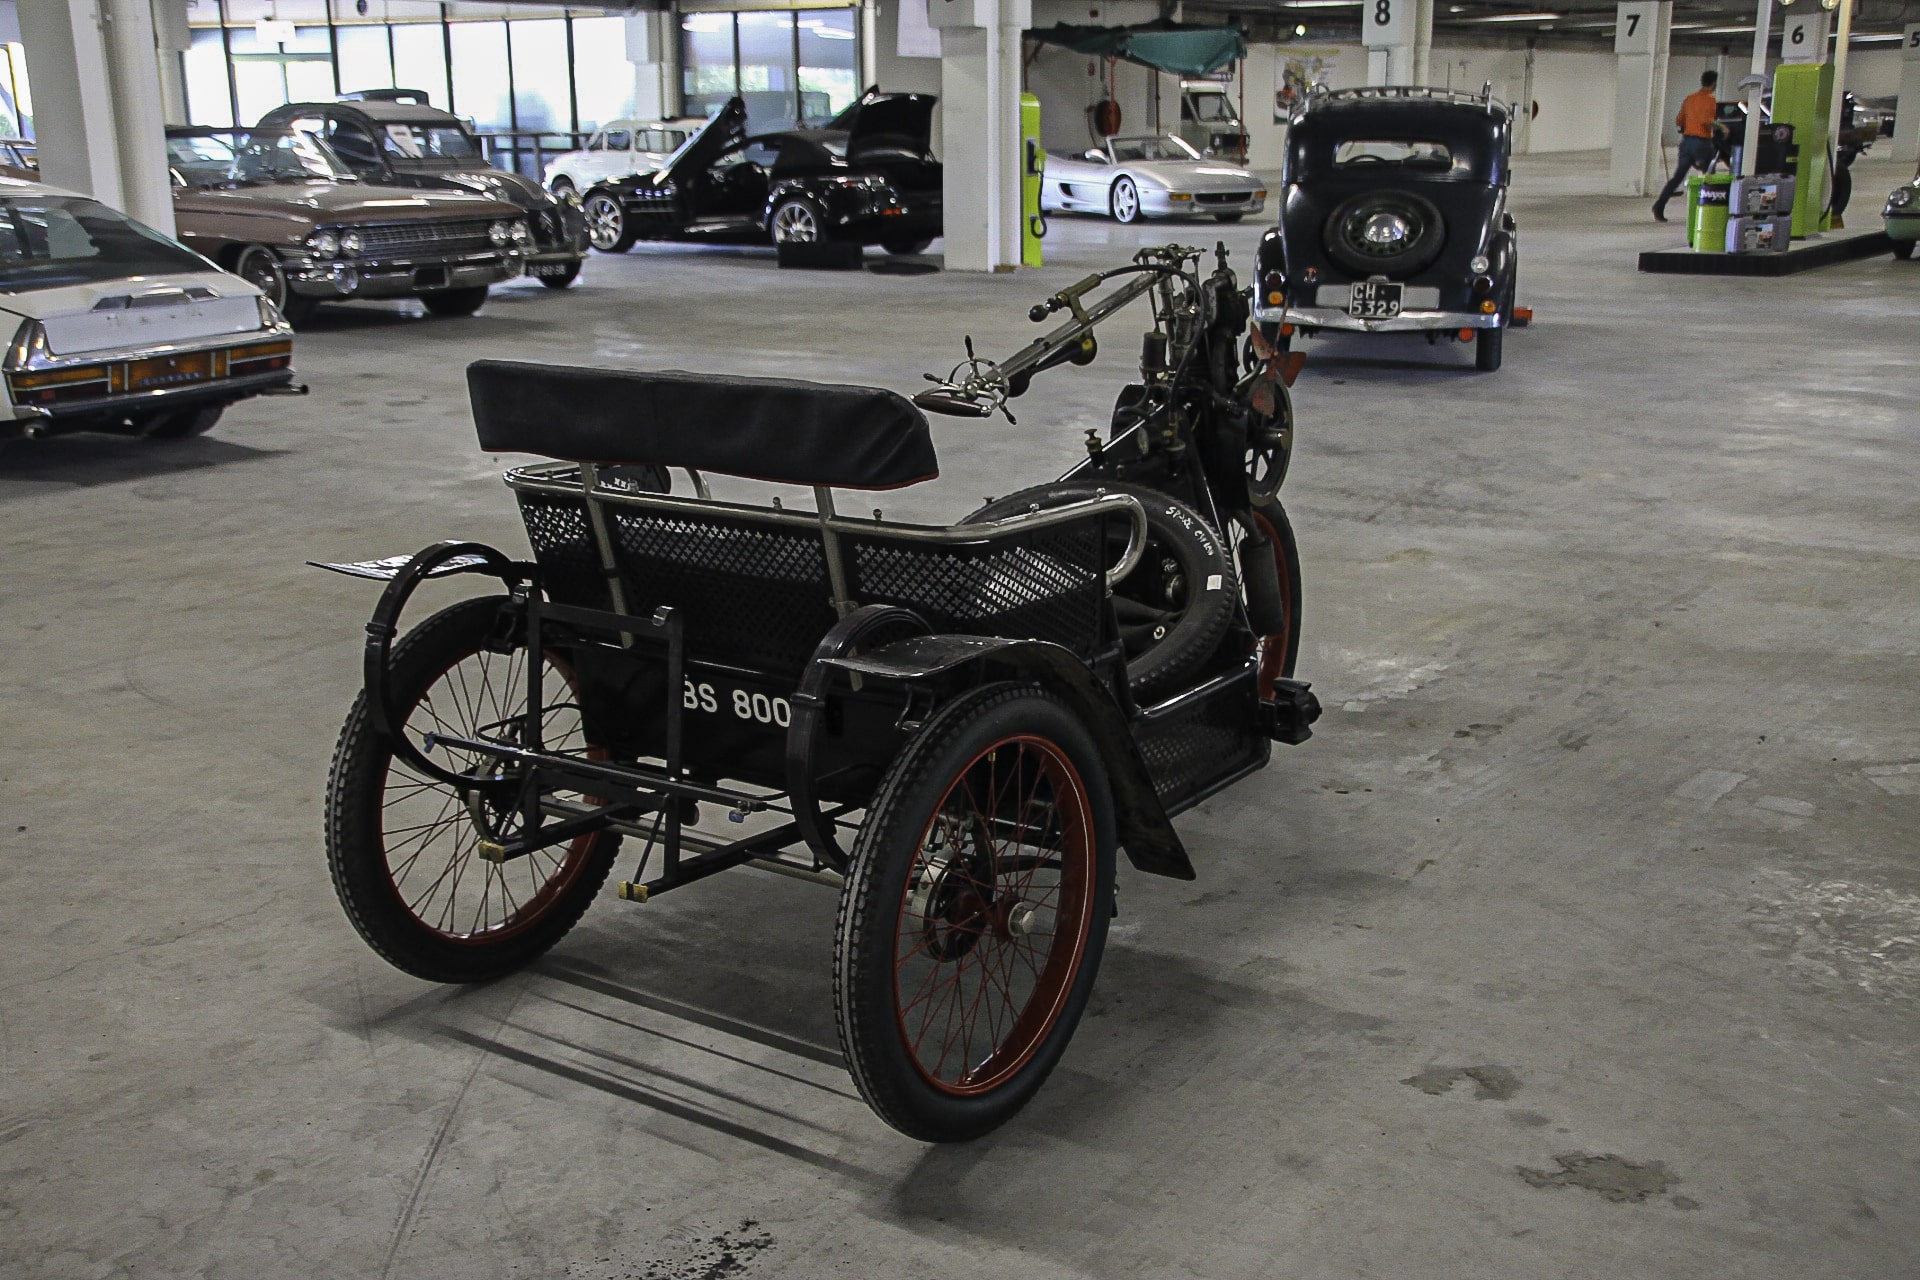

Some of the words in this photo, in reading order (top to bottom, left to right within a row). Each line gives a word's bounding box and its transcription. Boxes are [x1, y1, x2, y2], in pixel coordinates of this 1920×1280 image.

[1375, 0, 1390, 26] 8
[1626, 14, 1641, 37] 7
[1792, 24, 1804, 45] 6
[1909, 31, 1920, 48] 5
[1354, 283, 1376, 300] CH
[1352, 301, 1399, 316] 5329
[732, 689, 791, 727] 800
